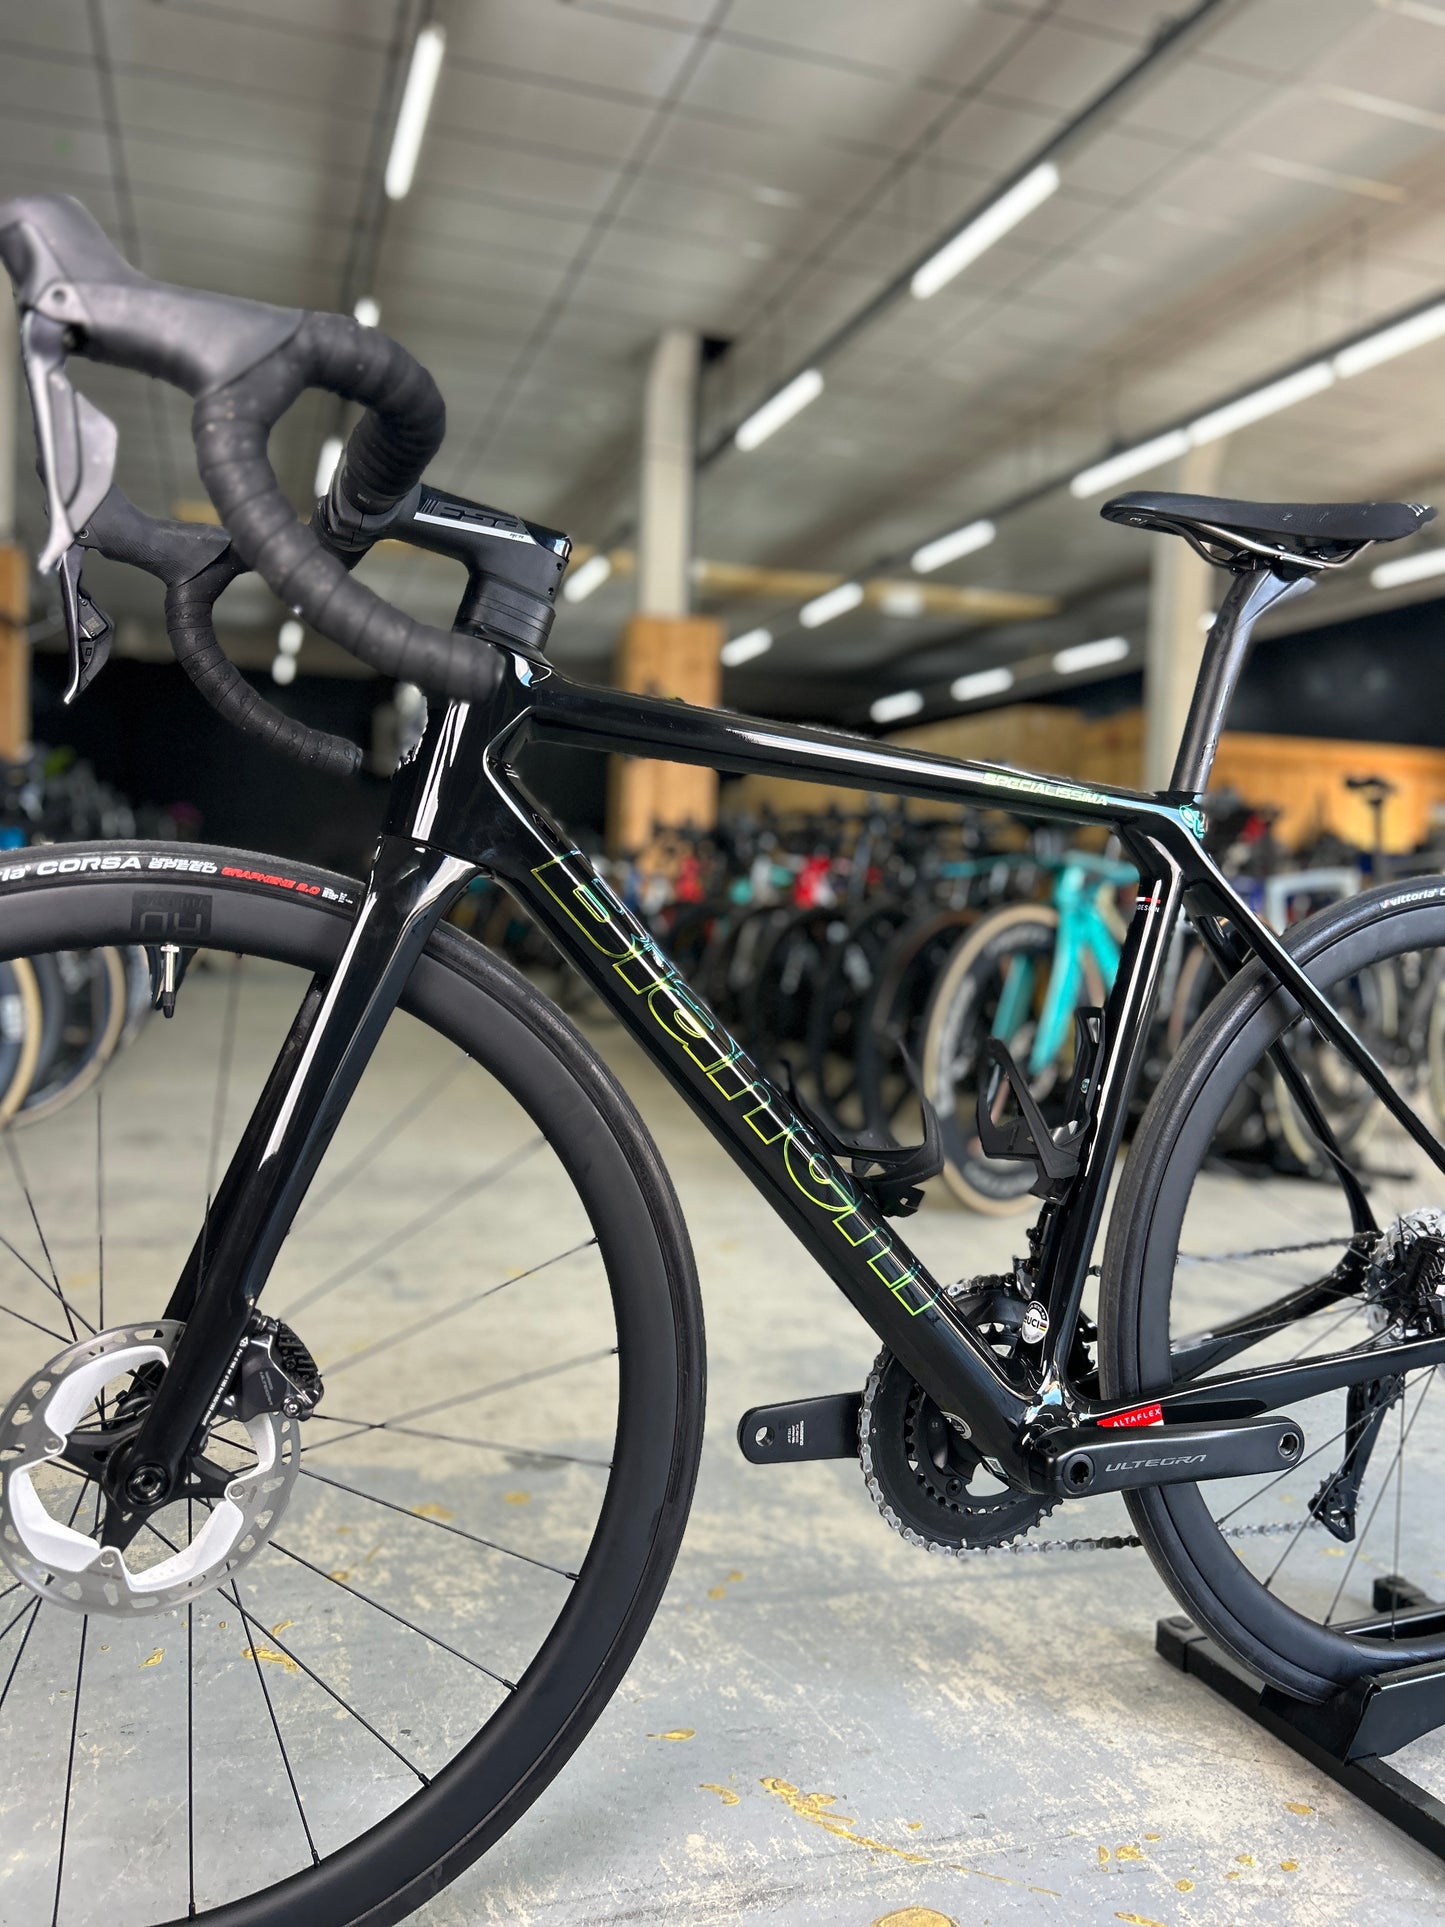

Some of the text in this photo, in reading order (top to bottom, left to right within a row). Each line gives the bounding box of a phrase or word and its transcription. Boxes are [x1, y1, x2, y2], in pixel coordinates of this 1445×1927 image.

[983, 773, 1108, 806] SPECIALISSIMA
[37, 857, 141, 876] CORSA
[296, 882, 320, 895] 2.0
[531, 850, 943, 1316] Bianchi
[1027, 1316, 1040, 1328] UCI
[1113, 1408, 1160, 1427] ALTAFLEX
[1105, 1454, 1207, 1472] ULTEGRA
